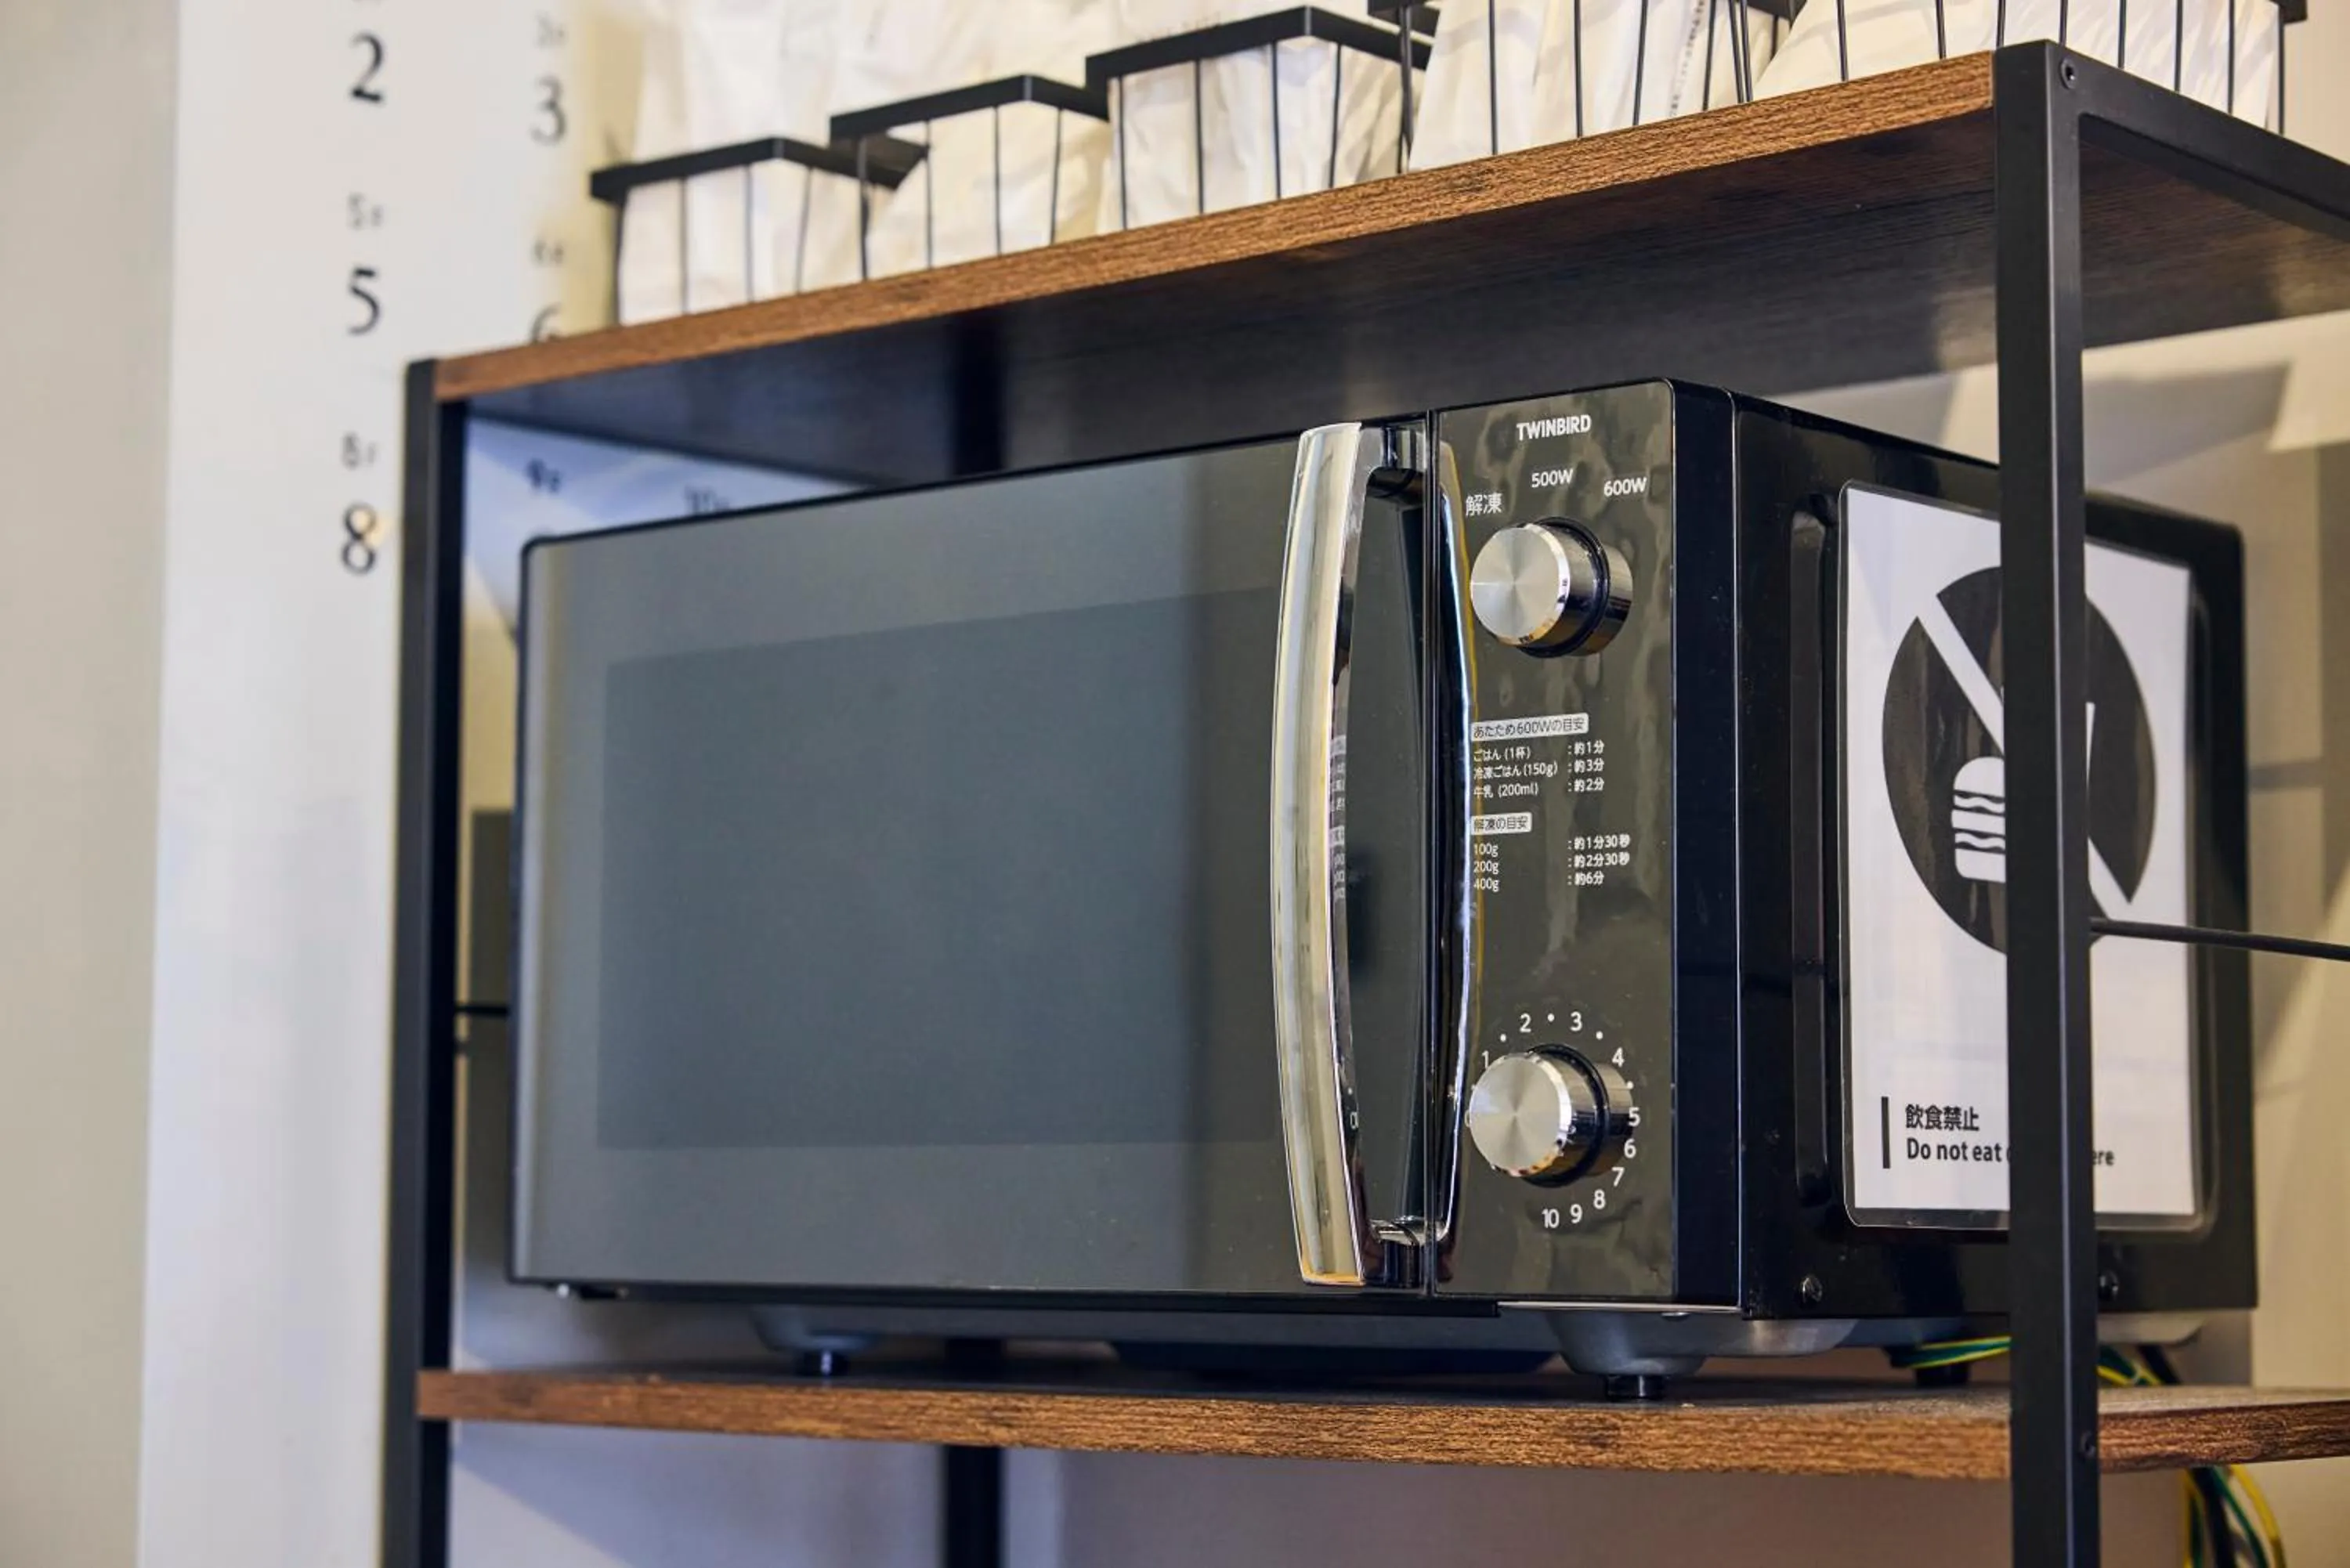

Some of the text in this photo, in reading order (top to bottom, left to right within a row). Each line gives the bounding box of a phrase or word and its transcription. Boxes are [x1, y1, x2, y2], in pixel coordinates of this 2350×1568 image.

[349, 32, 385, 105] 2
[530, 77, 566, 144] 3
[347, 266, 381, 337] 5
[1517, 414, 1592, 441] TWINBIRD
[1531, 468, 1574, 489] 500W
[1603, 476, 1647, 497] 600W
[1465, 493, 1503, 516] 解凍
[341, 502, 377, 575] 8
[1473, 717, 1585, 739] あたため600Wの目安
[1474, 815, 1528, 832] 解凍の目安
[1474, 844, 1499, 857] 100g
[1473, 862, 1499, 875] 200g
[1473, 878, 1499, 892] 400g
[1520, 1013, 1531, 1032] 2
[1571, 1011, 1582, 1031] 3
[1482, 1050, 1488, 1068] 1
[1612, 1047, 1624, 1067] 4
[1628, 1107, 1640, 1126] 5
[1905, 1104, 1979, 1132] 飲食禁止
[1624, 1139, 1636, 1158] 6
[1907, 1137, 1930, 1160] Do
[1937, 1140, 1968, 1161] not
[1973, 1143, 2002, 1162] eat
[1612, 1167, 1625, 1187] 7
[1593, 1190, 1605, 1209] 8
[1542, 1209, 1560, 1228] 10
[1570, 1204, 1582, 1223] 9
